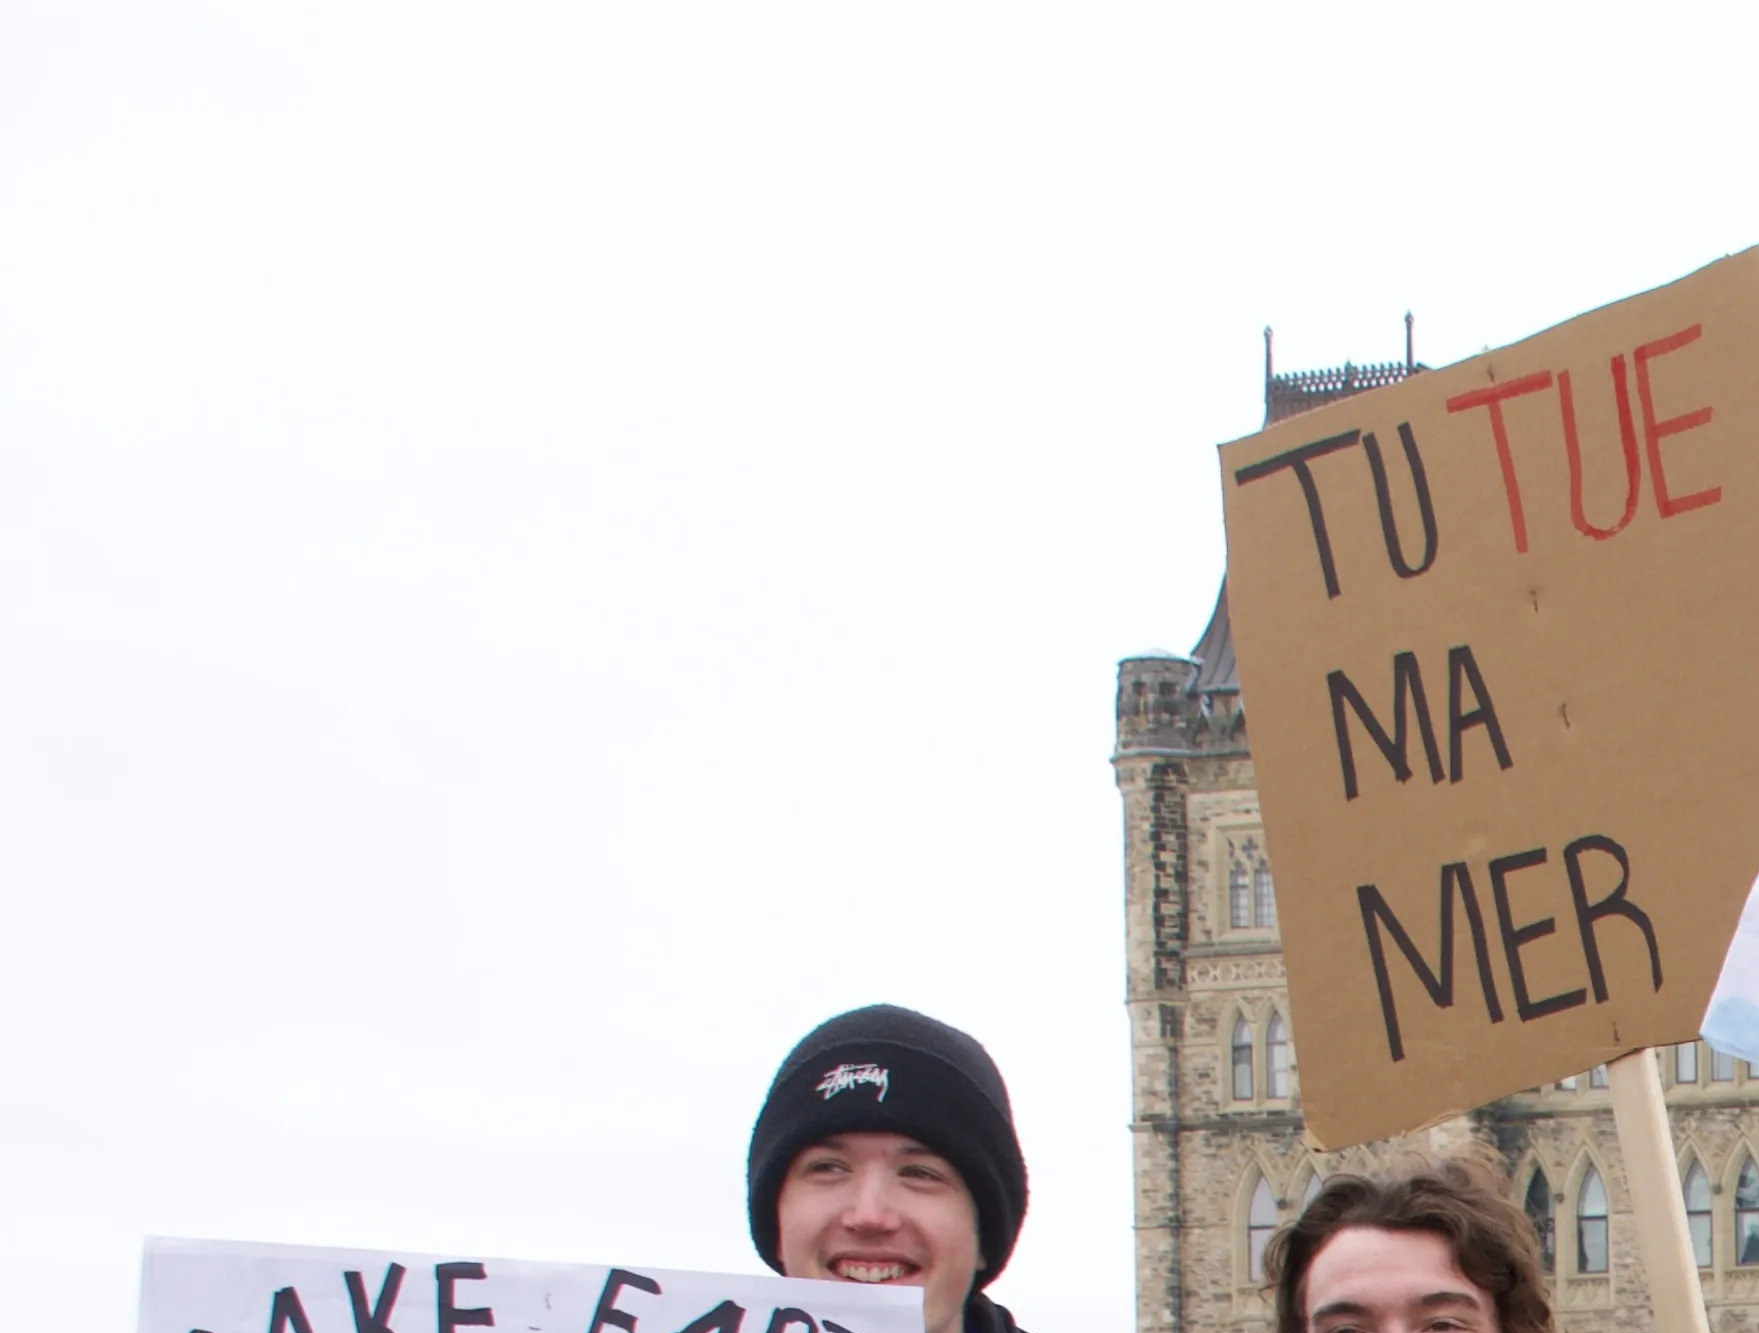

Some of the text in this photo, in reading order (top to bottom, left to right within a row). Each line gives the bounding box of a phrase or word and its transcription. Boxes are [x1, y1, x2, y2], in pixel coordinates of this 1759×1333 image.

[1235, 323, 1723, 600] TU TUE
[1326, 645, 1514, 803] MA
[1357, 834, 1664, 1064] MER
